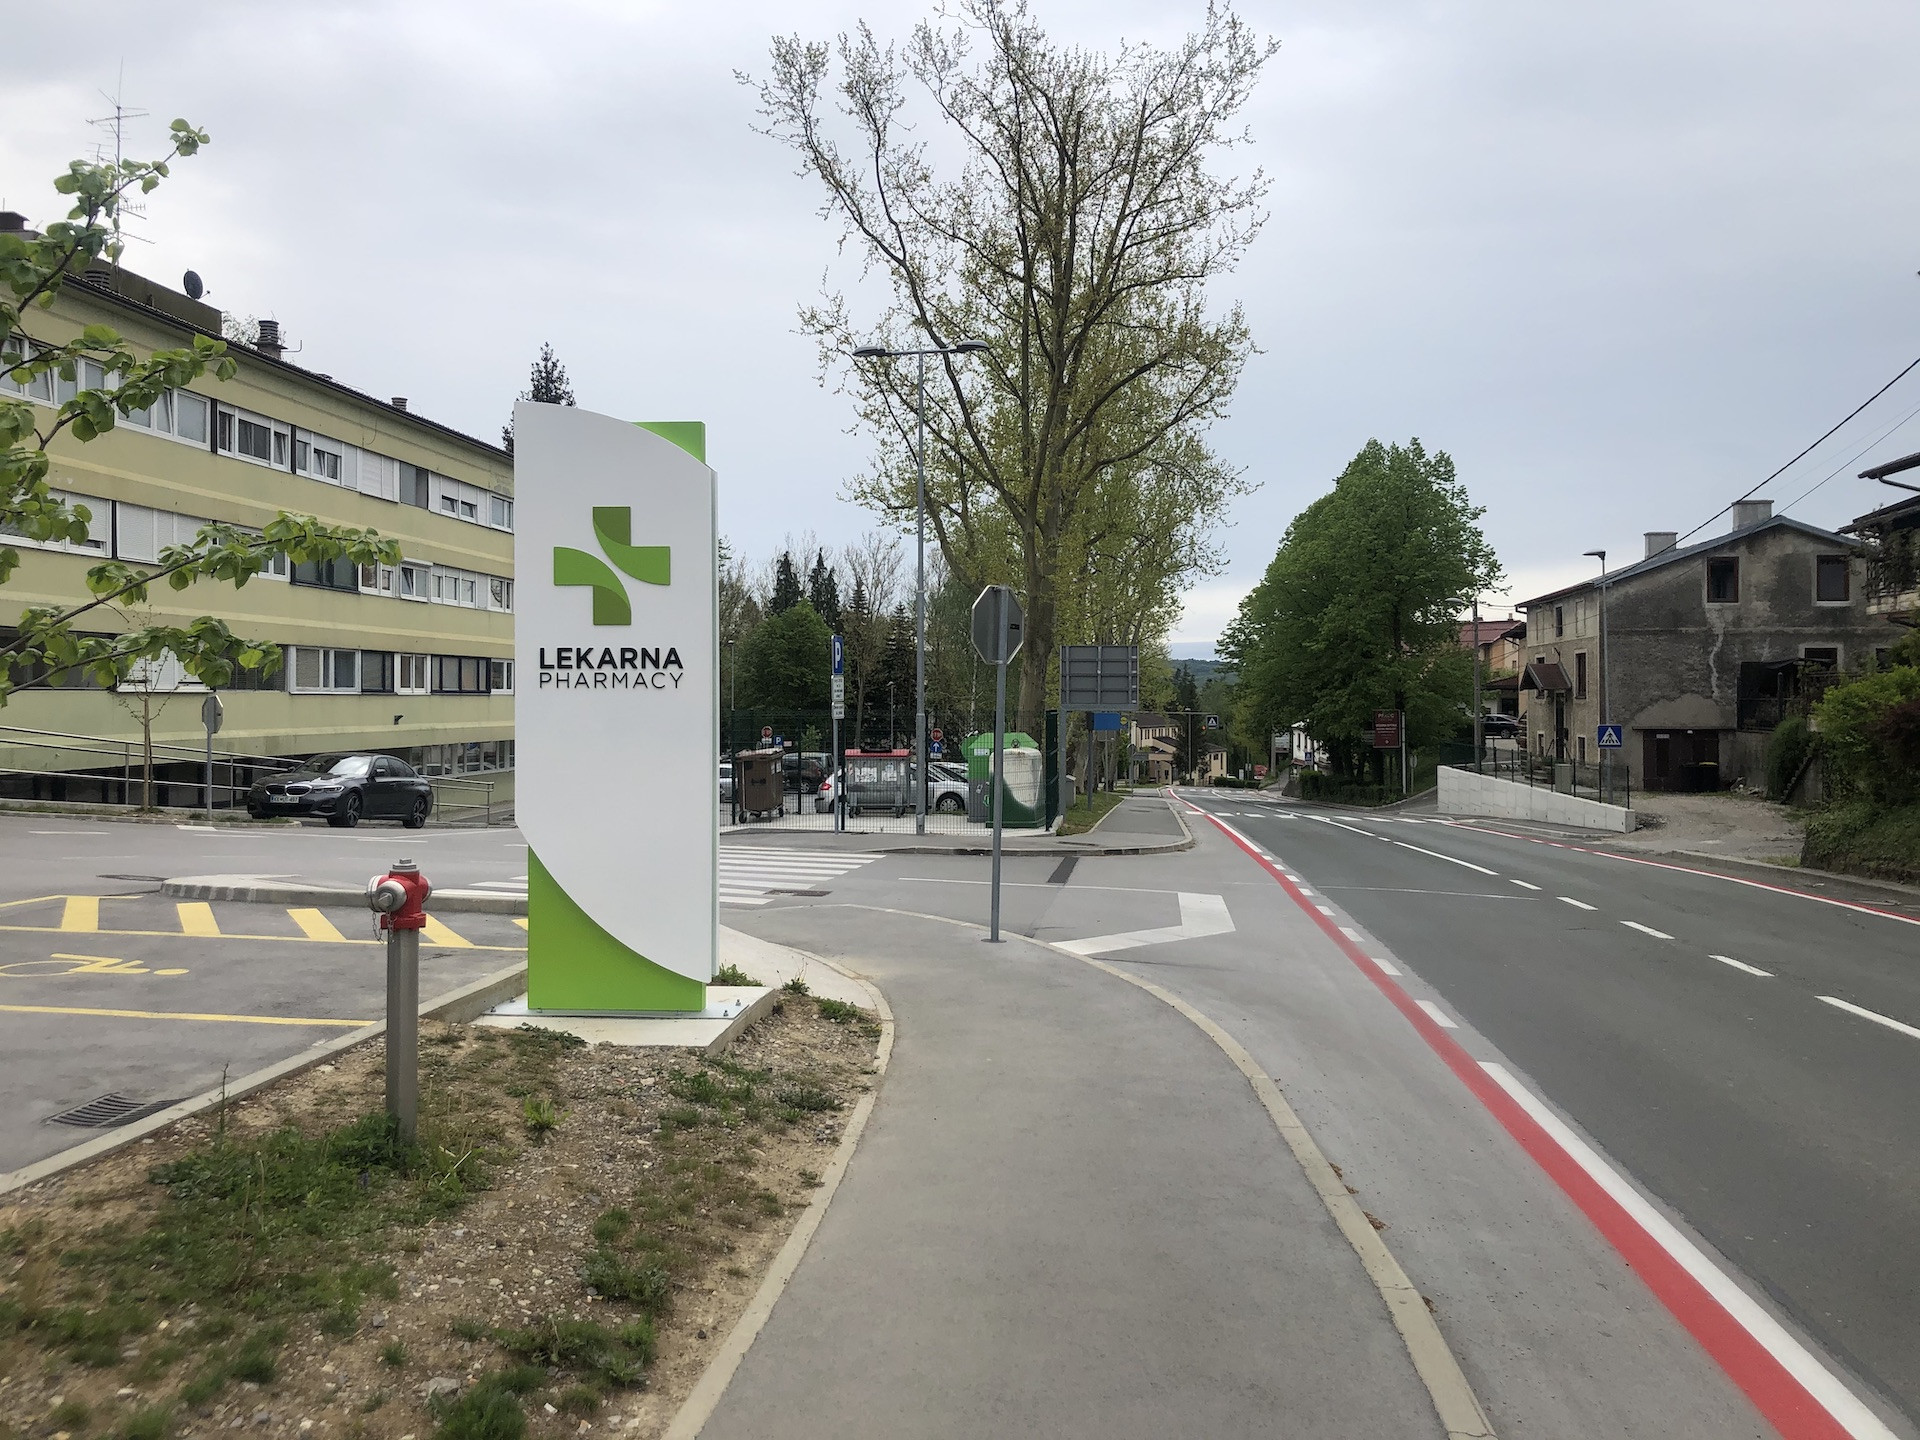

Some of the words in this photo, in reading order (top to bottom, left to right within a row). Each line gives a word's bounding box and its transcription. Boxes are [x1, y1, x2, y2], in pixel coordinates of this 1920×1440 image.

[539, 647, 684, 669] LEKARNA
[835, 641, 841, 669] P
[539, 672, 684, 689] PHARMACY
